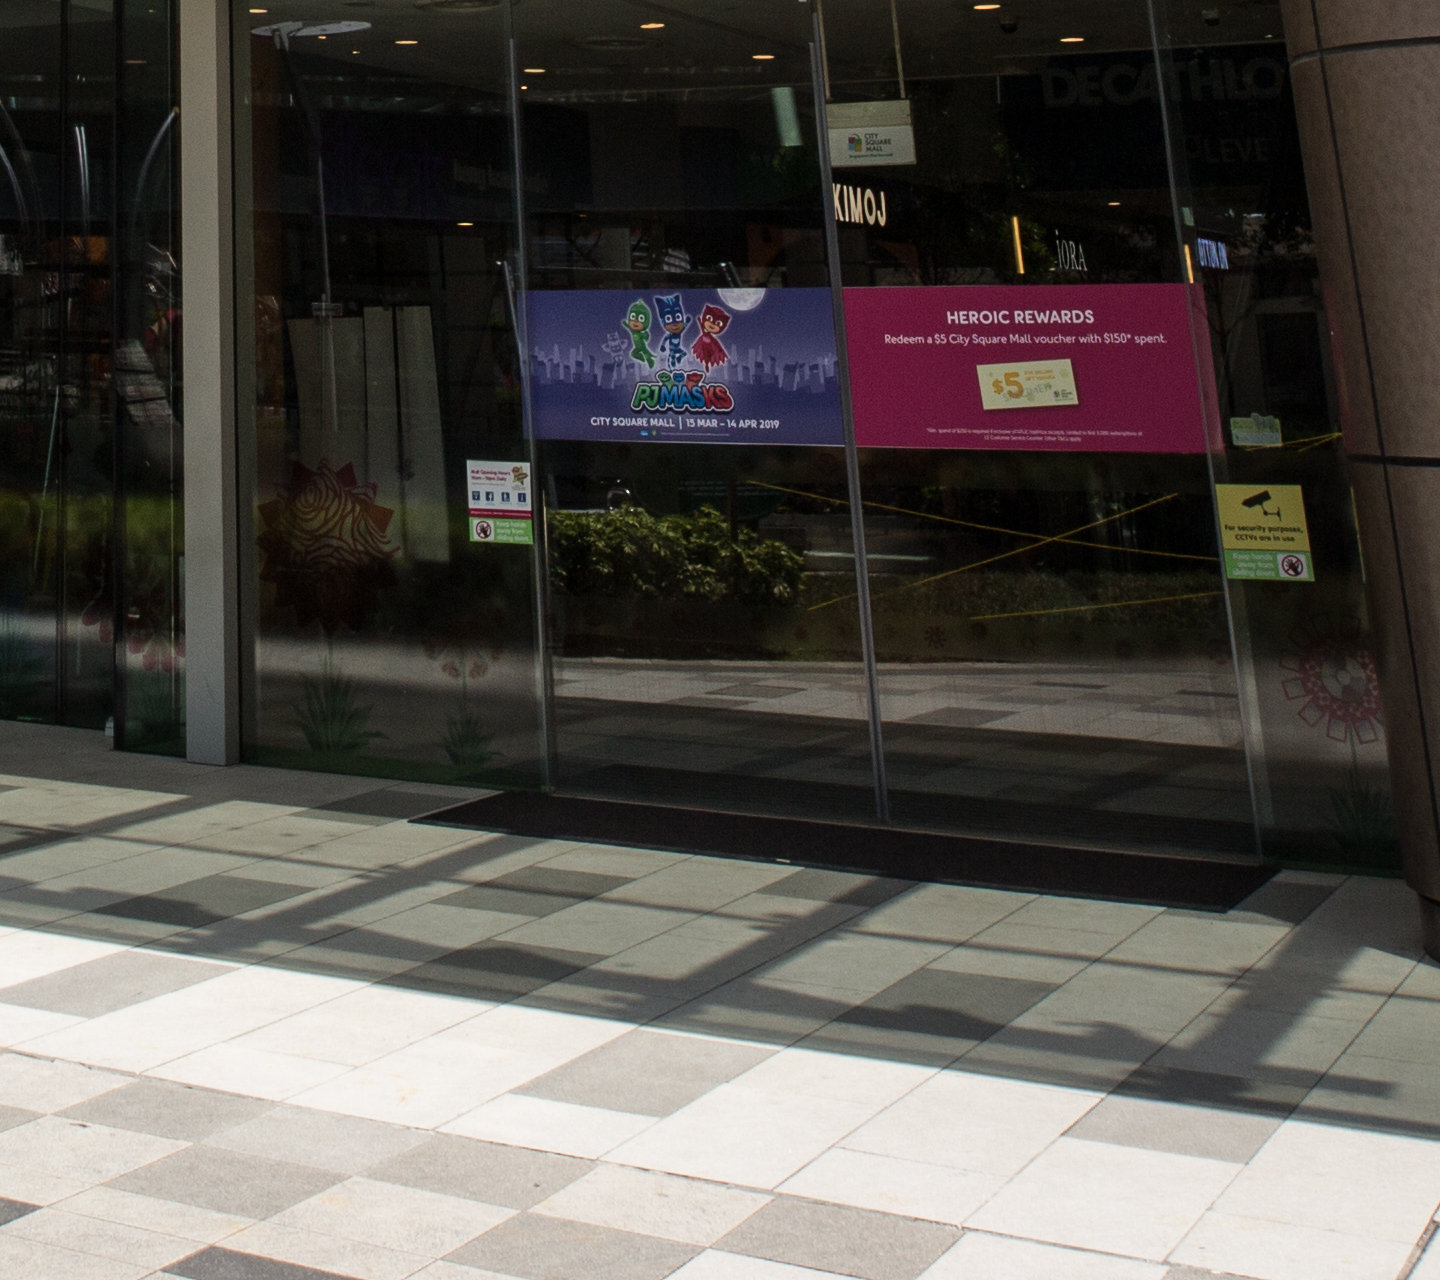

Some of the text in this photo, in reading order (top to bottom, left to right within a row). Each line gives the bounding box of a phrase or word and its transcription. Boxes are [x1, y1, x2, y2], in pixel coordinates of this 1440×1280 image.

[946, 309, 1096, 325] HEROIC REWARDS
[884, 333, 925, 345] Redeem
[934, 332, 948, 346] $5
[949, 333, 970, 347] City
[972, 333, 1008, 347] Square
[1009, 332, 1032, 345] Mall
[1033, 332, 1077, 345] voucher
[1078, 332, 1102, 345] with
[1134, 333, 1168, 348] spent.
[660, 384, 735, 411] MASKS
[590, 417, 611, 427] CITY
[612, 417, 649, 428] SQUARE
[650, 418, 676, 428] MALL
[686, 418, 696, 428] 15
[697, 419, 719, 429] MAR
[727, 419, 738, 429] 14
[739, 419, 758, 430] APR
[759, 419, 780, 430] 2019
